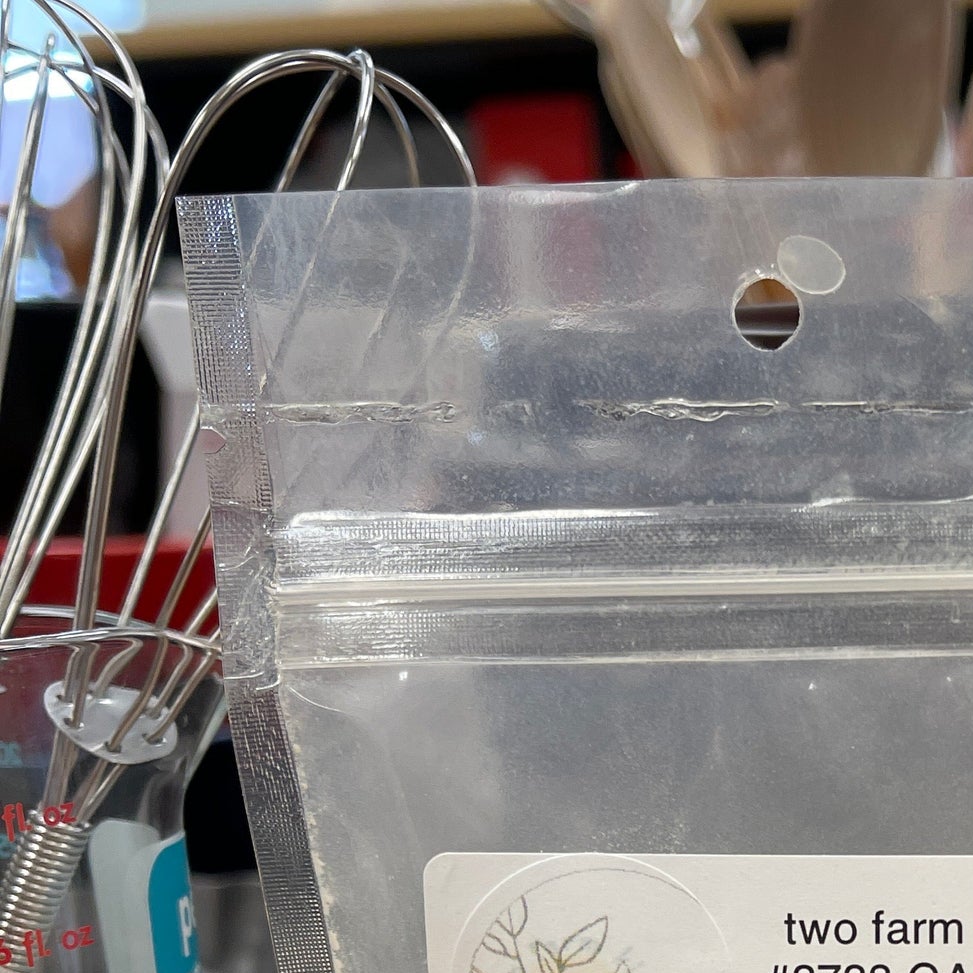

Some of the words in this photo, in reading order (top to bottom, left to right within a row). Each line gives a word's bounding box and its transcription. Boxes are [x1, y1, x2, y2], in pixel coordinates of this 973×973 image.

[43, 802, 76, 827] oz
[61, 925, 94, 951] oz
[783, 912, 858, 945] two
[871, 910, 963, 945] farm
